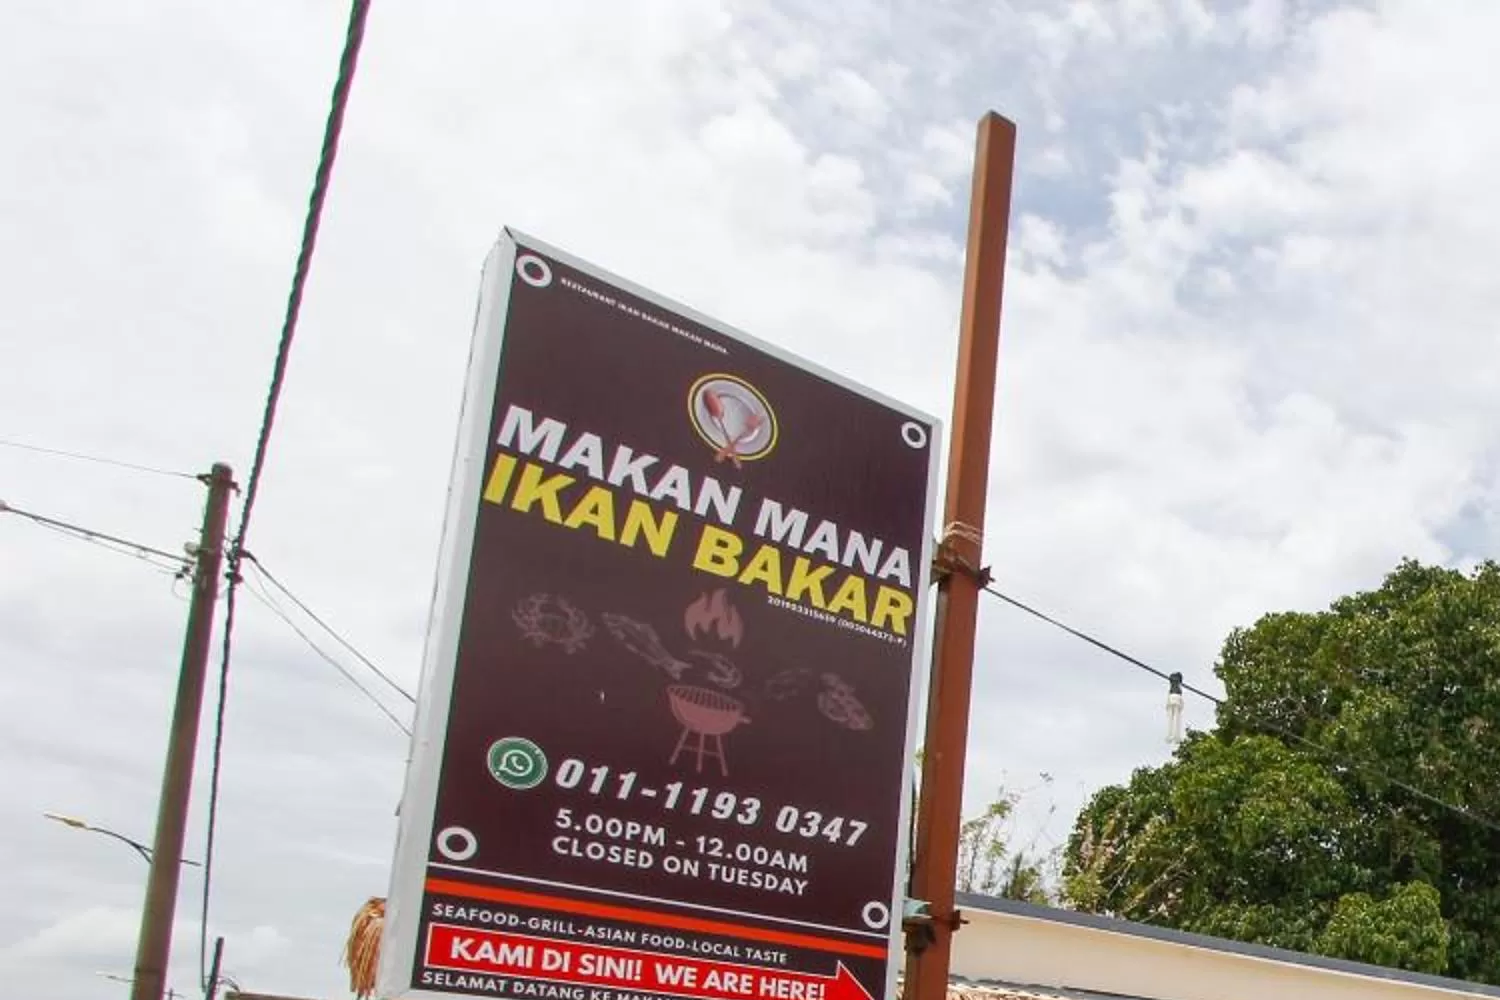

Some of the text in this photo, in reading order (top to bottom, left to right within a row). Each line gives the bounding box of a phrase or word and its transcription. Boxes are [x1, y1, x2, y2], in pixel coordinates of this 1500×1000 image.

[496, 403, 912, 588] MAKAN MANA
[483, 451, 914, 636] IKAN BAKAR
[555, 758, 868, 847] 011-1193 0347
[552, 836, 809, 896] CLOSED ON TUESDAY
[555, 808, 665, 847] 5.00PM
[696, 835, 808, 873] 12.00AM
[432, 903, 788, 965] SEAFOOD-GRILL-ASIAN FOOD-LOCAL TASTE
[422, 971, 510, 993] SELAMAT
[450, 936, 535, 968] KAMI
[541, 948, 572, 973] DI
[577, 953, 642, 981] SINI!
[655, 962, 698, 987] WE
[702, 969, 754, 996] ARE
